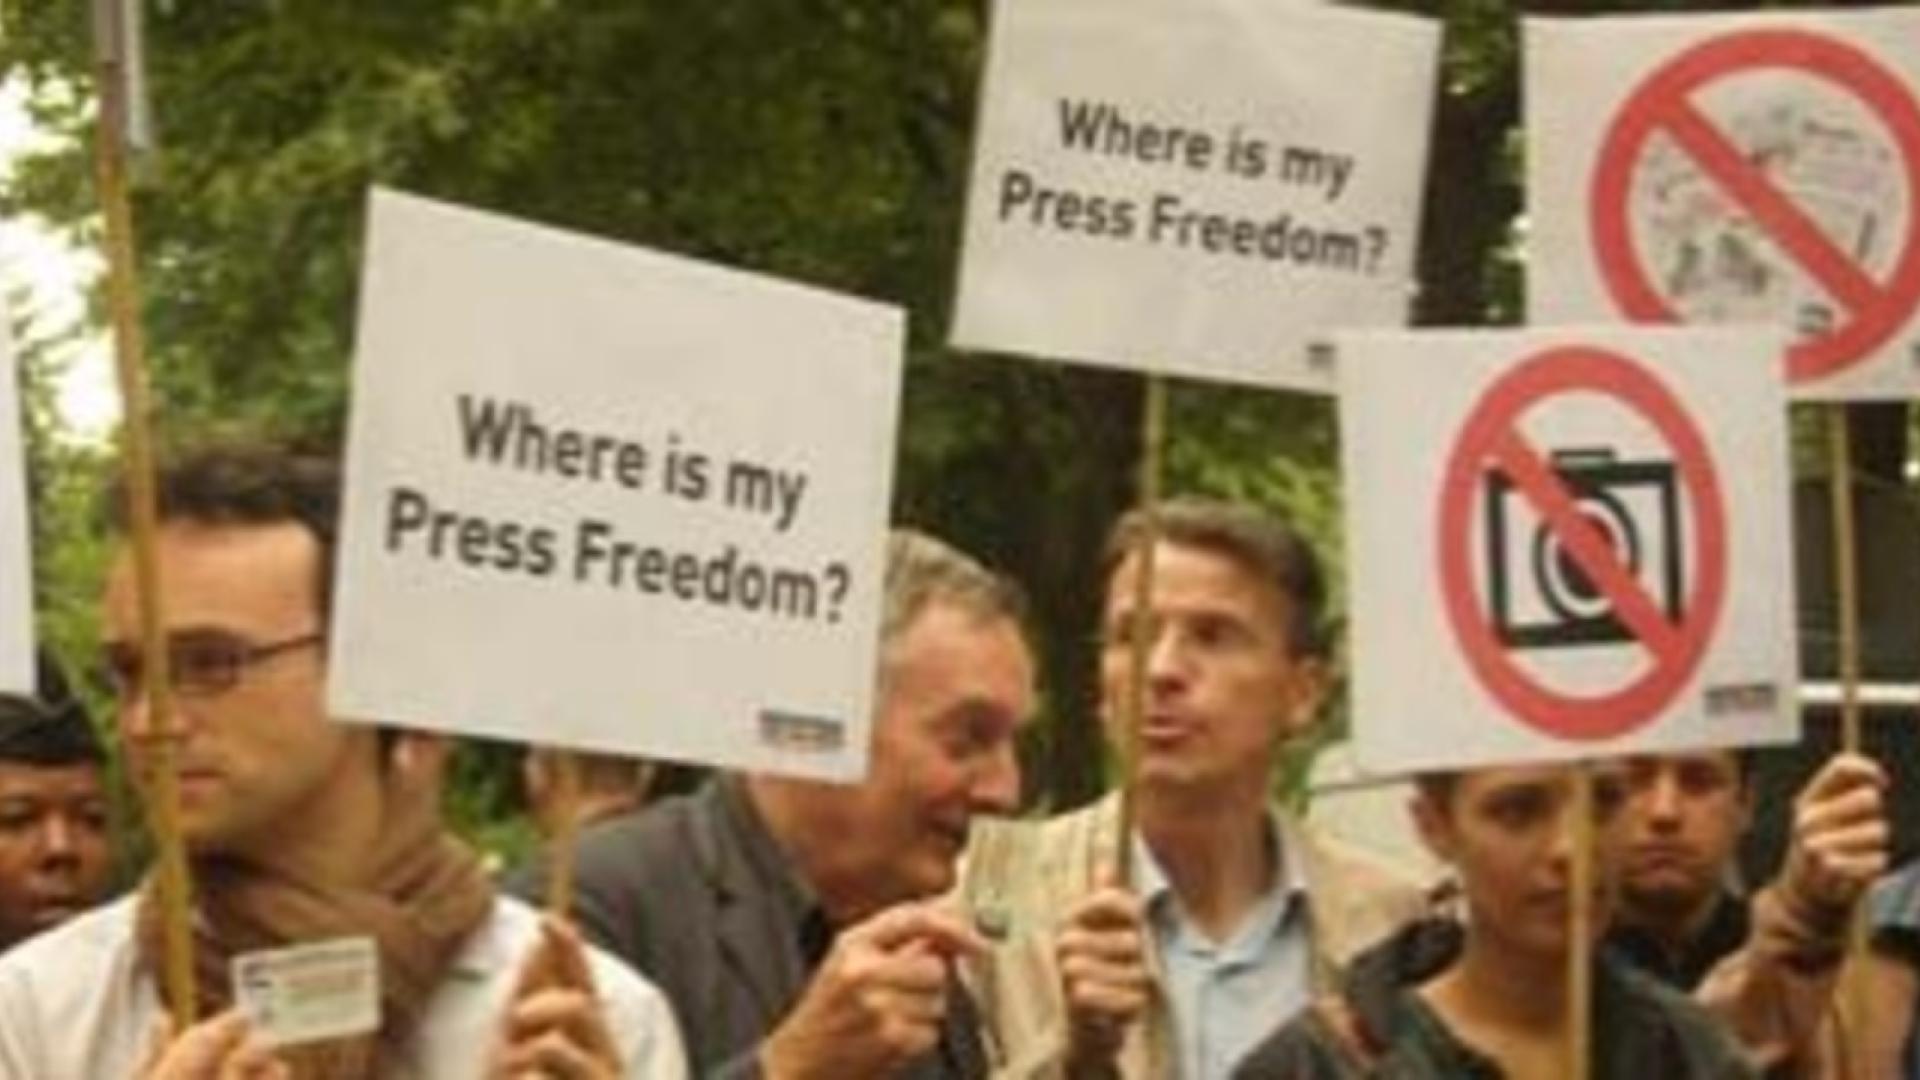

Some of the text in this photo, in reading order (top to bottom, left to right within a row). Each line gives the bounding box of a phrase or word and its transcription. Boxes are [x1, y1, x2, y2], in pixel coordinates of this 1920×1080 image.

[1059, 98, 1353, 199] Where is my
[999, 170, 1388, 274] Press Freedom?
[456, 394, 808, 530] Where is my
[385, 487, 851, 624] Press Freedom?
